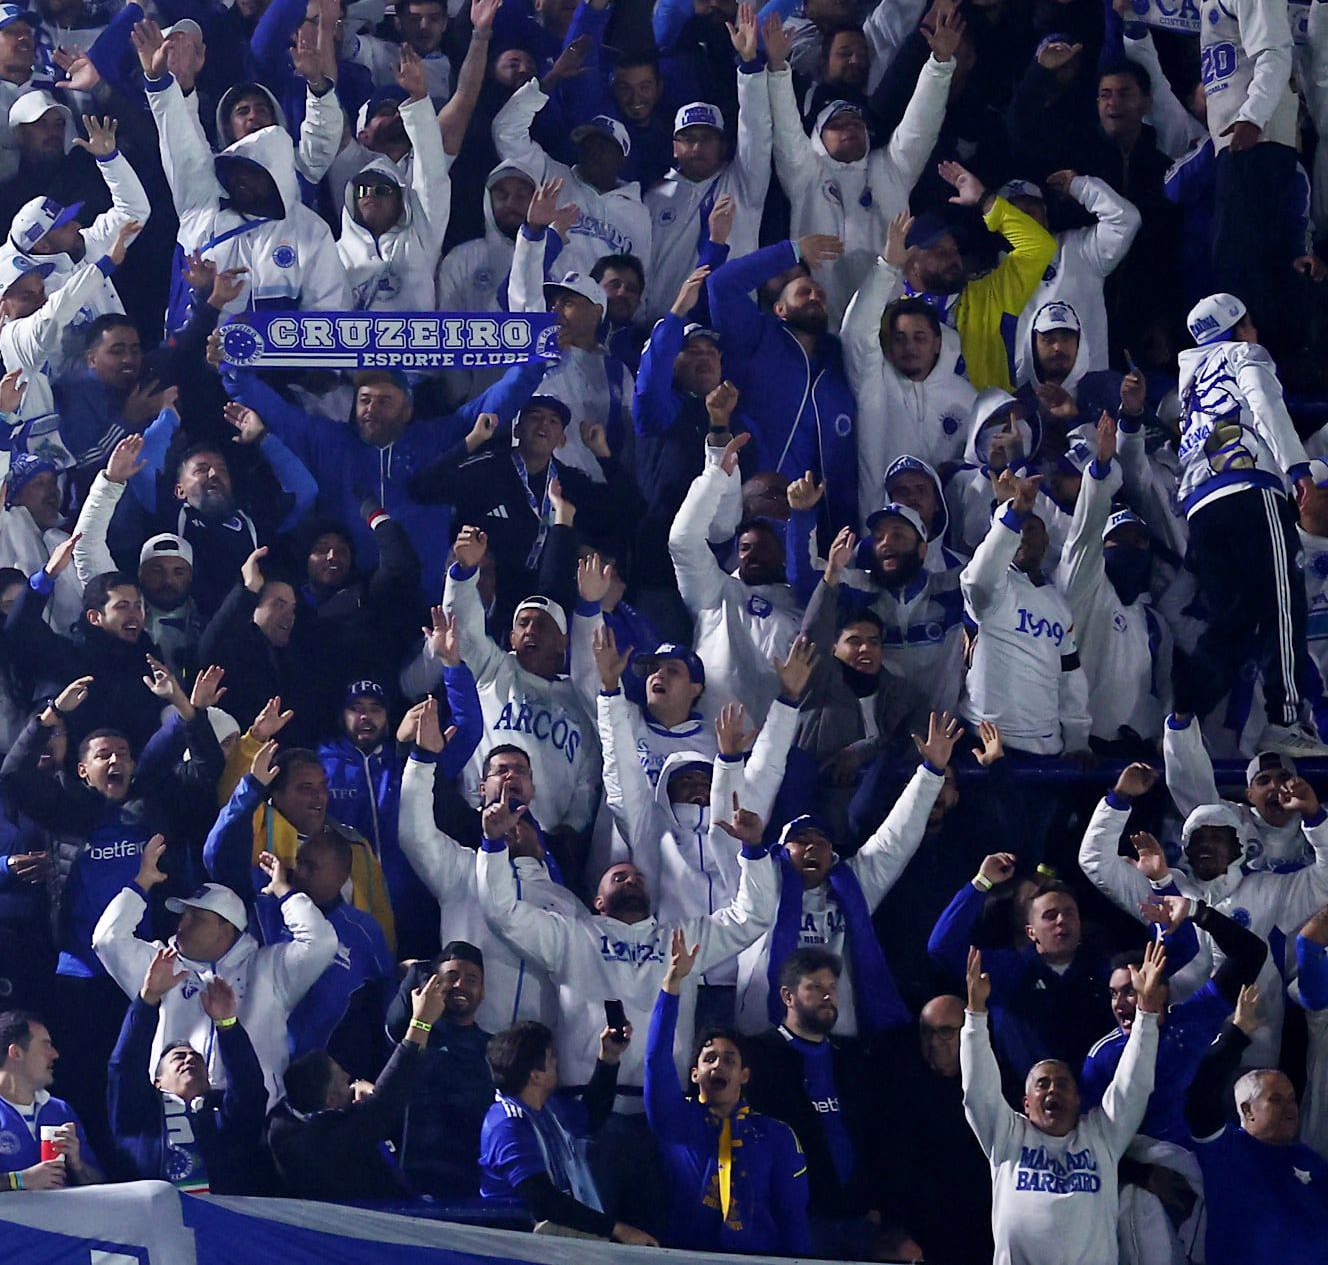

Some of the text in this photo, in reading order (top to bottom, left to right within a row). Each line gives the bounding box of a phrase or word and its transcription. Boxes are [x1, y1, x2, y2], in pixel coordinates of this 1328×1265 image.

[267, 318, 531, 350] CRUZEIRO
[362, 351, 529, 367] ESPORTE CLUBE
[493, 702, 580, 764] ARCOS
